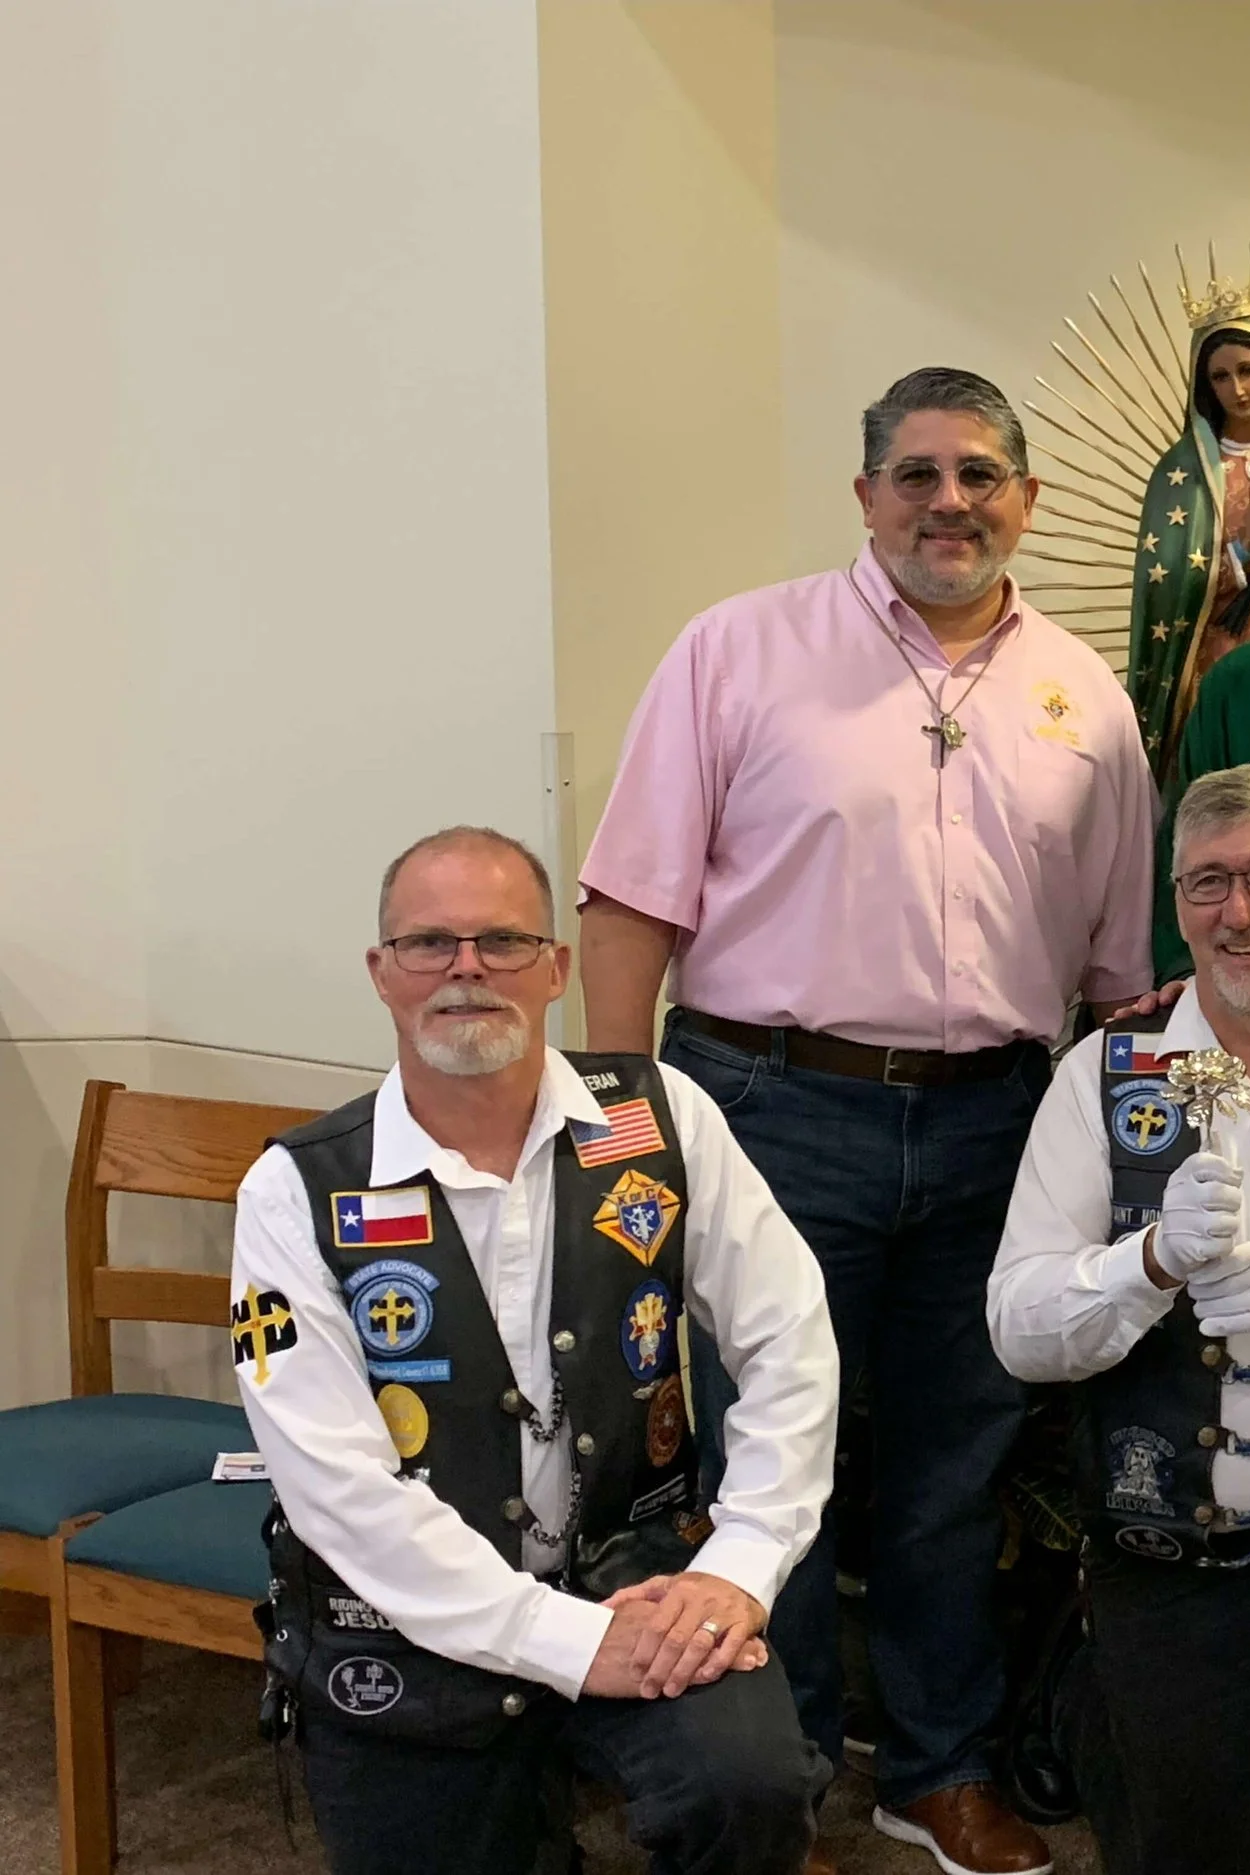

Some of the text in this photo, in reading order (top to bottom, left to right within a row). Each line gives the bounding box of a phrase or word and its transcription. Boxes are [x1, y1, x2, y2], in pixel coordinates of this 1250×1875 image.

[617, 1193, 626, 1206] K
[645, 1187, 656, 1199] C
[381, 1261, 433, 1287] ADVOCATE
[333, 1611, 395, 1631] JESU
